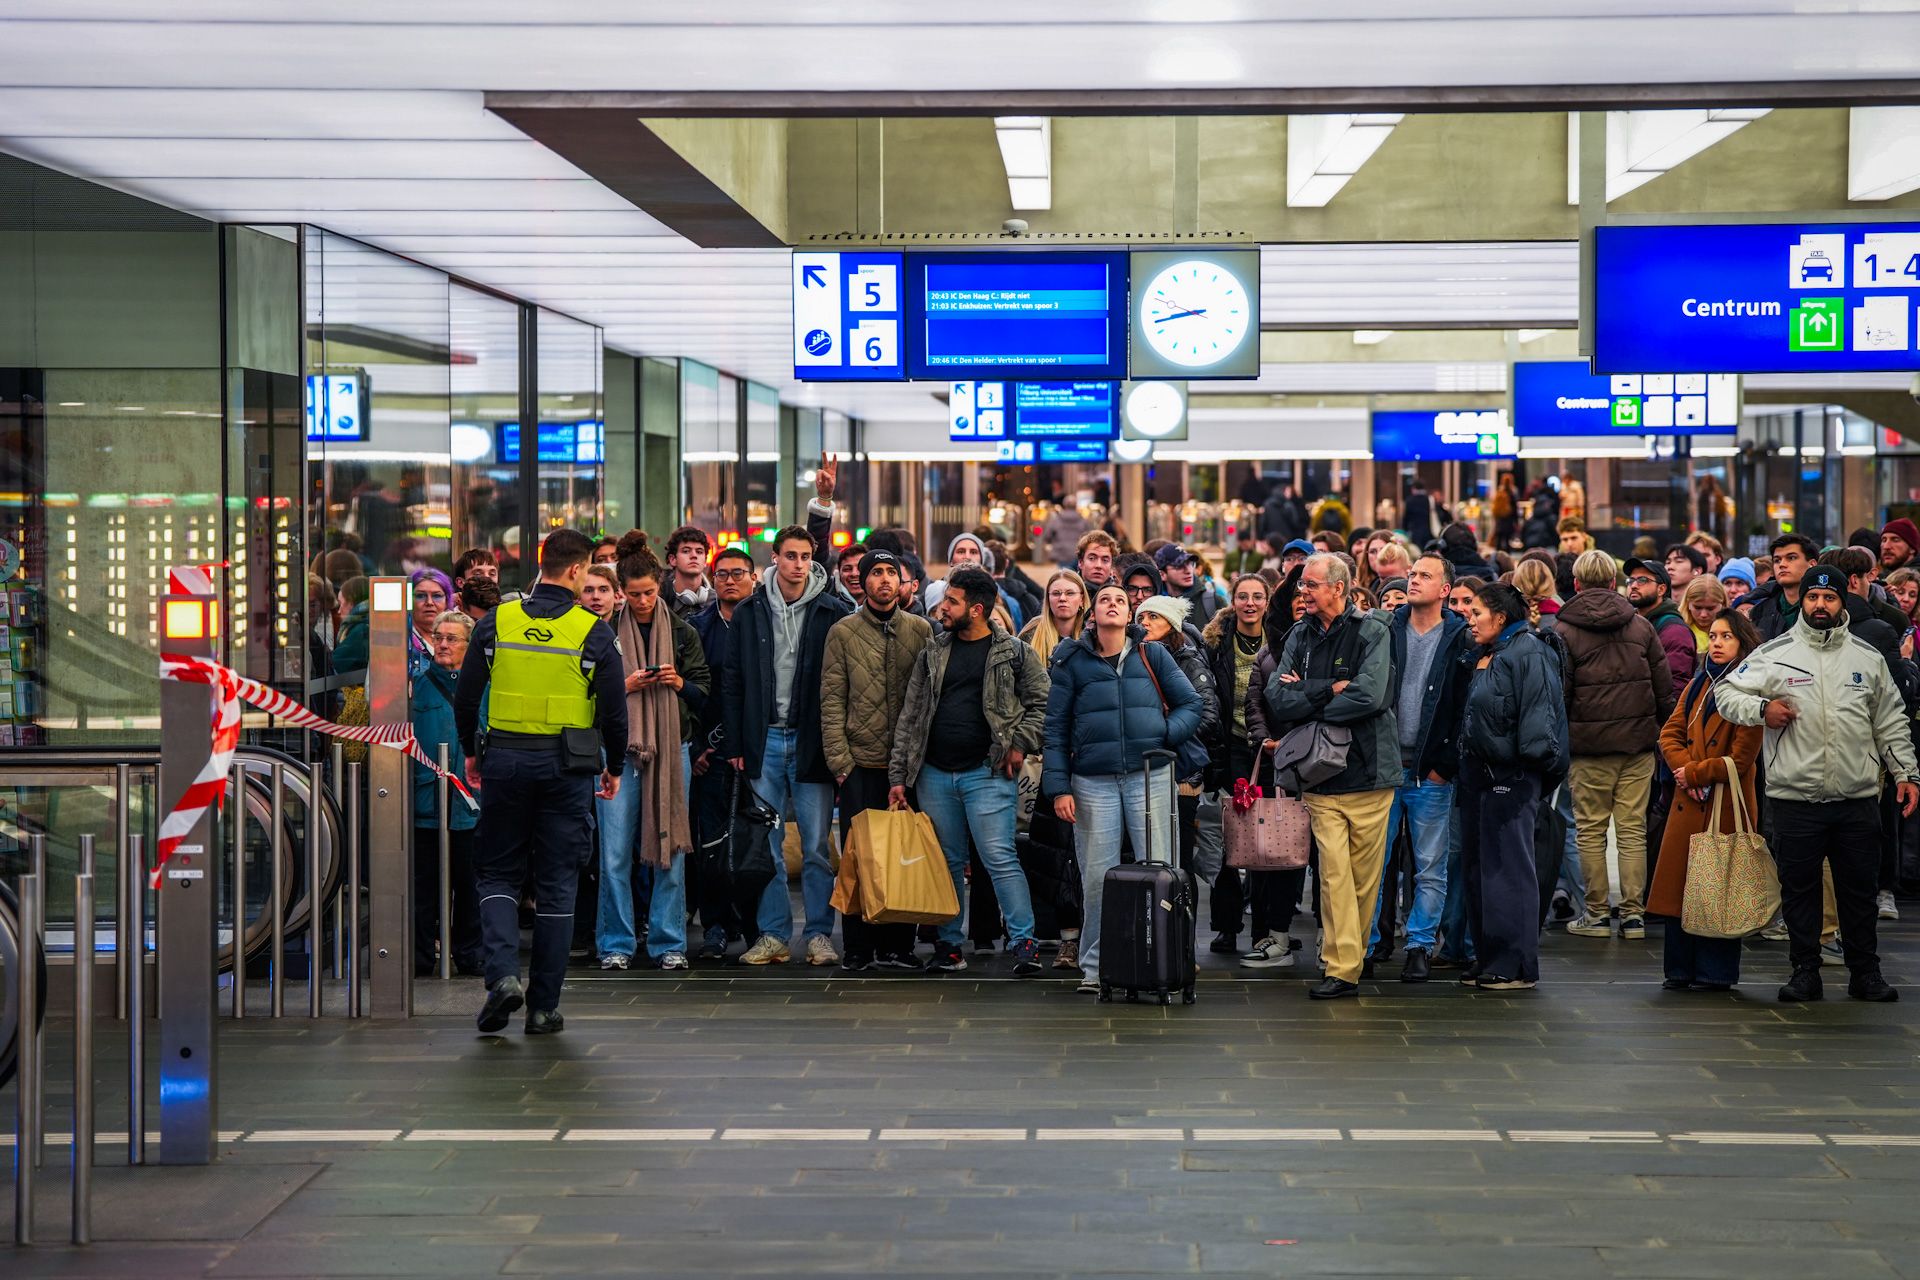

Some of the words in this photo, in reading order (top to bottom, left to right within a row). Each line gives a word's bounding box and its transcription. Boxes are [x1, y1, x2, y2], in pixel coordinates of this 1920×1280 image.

[865, 282, 881, 307] 5
[931, 292, 949, 300] 20:43
[950, 292, 958, 300] IC
[958, 292, 972, 300] Den
[973, 292, 990, 301] Haag
[931, 302, 949, 310] 21:03
[950, 302, 958, 310] IC
[958, 302, 993, 310] Enkhuizen:
[993, 302, 1020, 310] Vertrekt
[1034, 303, 1053, 311] spoor
[1053, 301, 1059, 309] 3
[1682, 298, 1781, 317] Centrum
[865, 336, 882, 362] 6
[973, 356, 997, 364] Helder:
[997, 356, 1024, 364] Vertrekt
[1038, 357, 1057, 365] spoor
